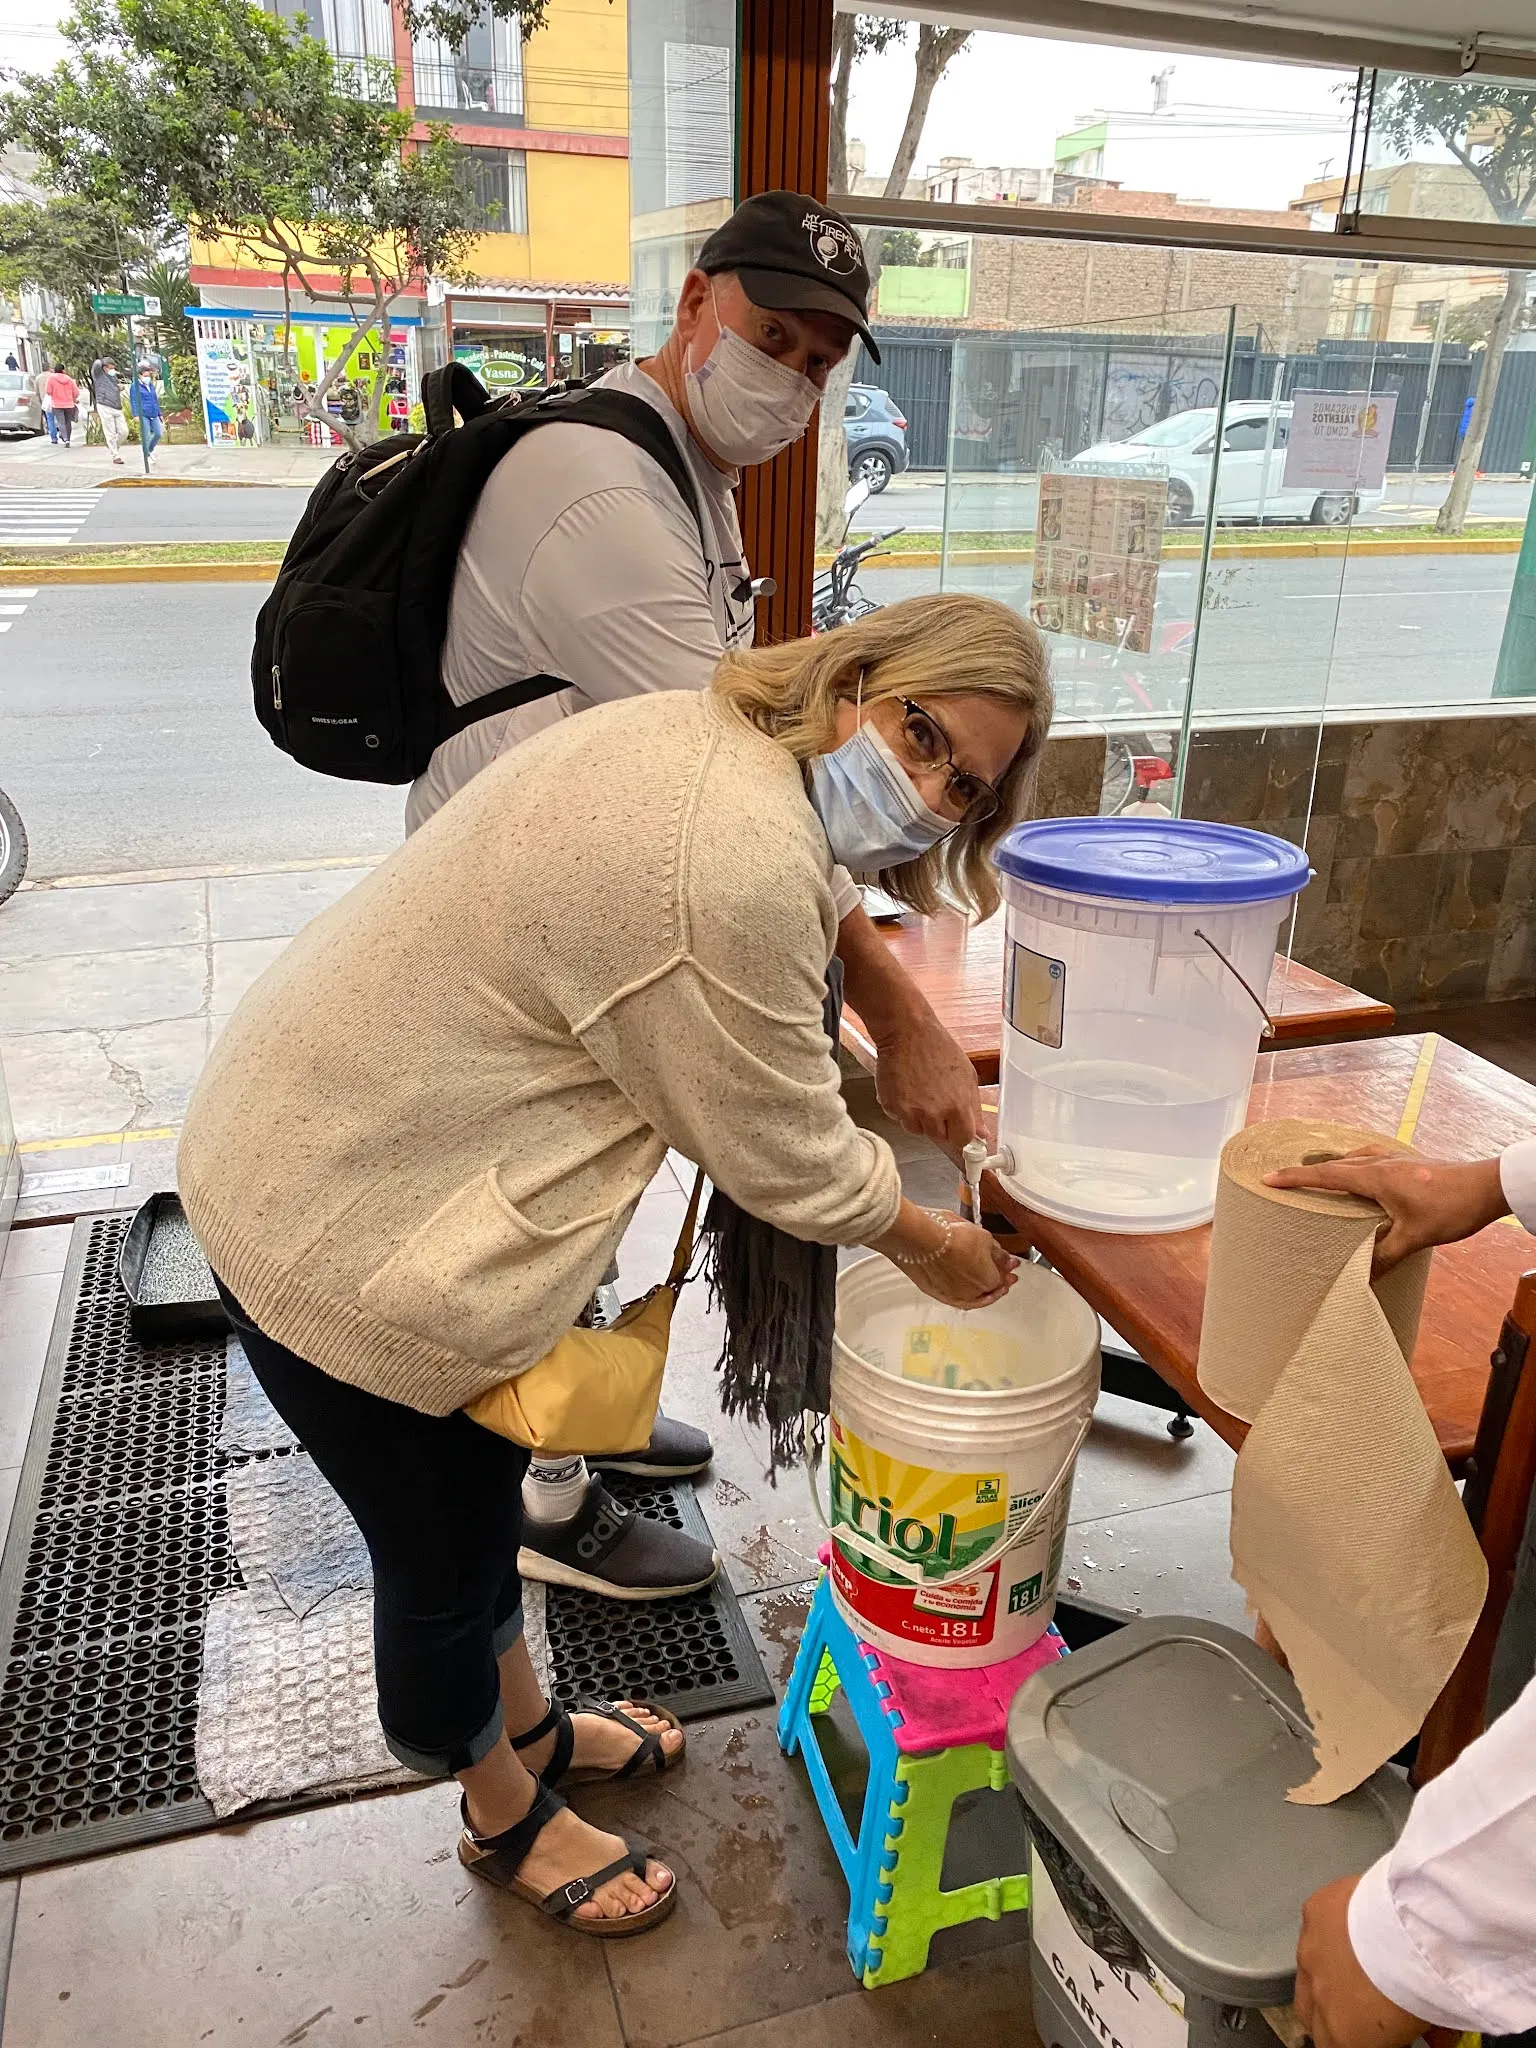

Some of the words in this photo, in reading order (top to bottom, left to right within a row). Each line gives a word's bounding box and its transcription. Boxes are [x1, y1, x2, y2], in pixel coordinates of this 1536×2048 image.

[805, 212, 820, 223] MY
[844, 244, 863, 267] PLAN
[485, 367, 518, 379] Yasna
[984, 1481, 992, 1490] 5
[831, 1448, 958, 1560] Friol
[920, 1589, 944, 1602] Cuida
[952, 1597, 983, 1606] comida
[1011, 1592, 1029, 1611] 18
[1032, 1586, 1040, 1600] L
[935, 1600, 977, 1611] economía
[901, 1620, 911, 1630] C.
[912, 1624, 936, 1635] neto
[940, 1622, 967, 1637] 18
[972, 1622, 982, 1636] L
[930, 1636, 951, 1644] Aceite
[952, 1637, 978, 1645] Vegetal
